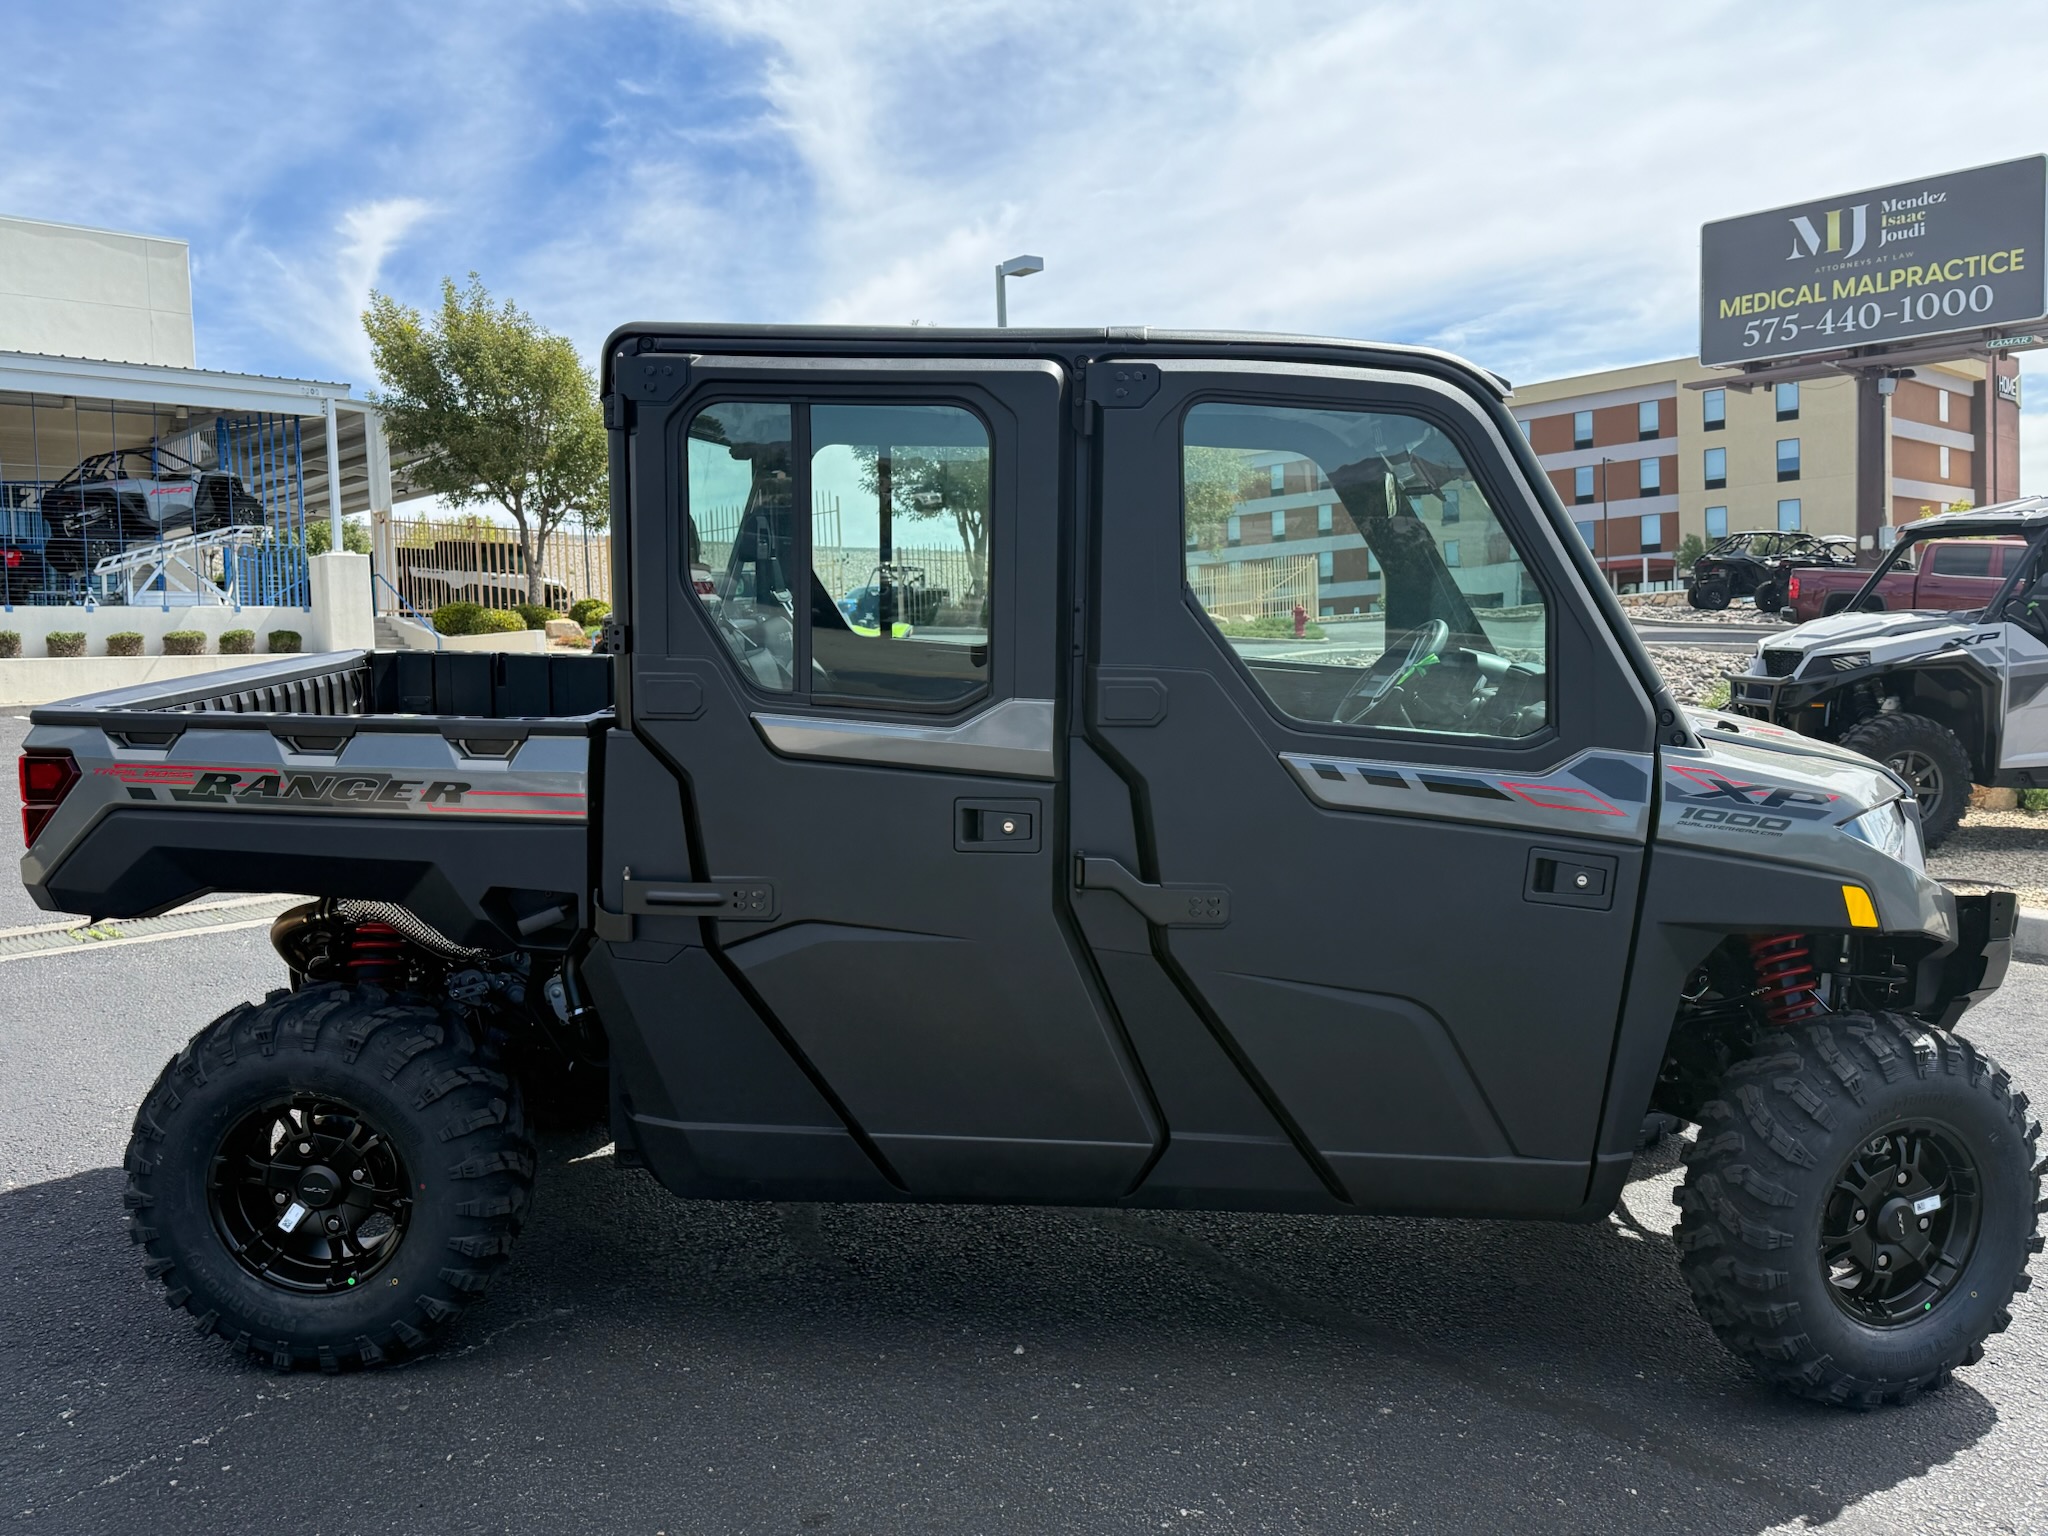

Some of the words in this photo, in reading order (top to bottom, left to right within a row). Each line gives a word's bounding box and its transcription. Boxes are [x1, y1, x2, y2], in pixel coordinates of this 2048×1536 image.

[1881, 191, 1946, 214] Mendez
[1881, 210, 1926, 228] Isaac
[1878, 222, 1926, 248] Joudi
[1814, 258, 1872, 274] ATTORNEYS
[1876, 256, 1889, 264] AT
[1893, 251, 1914, 261] LAW
[1719, 283, 1827, 319] MEDICAL
[1832, 248, 2025, 300] MALPRACTICE
[1743, 284, 1994, 347] 575-440-1000
[1990, 336, 2029, 347] LAMAR
[1952, 631, 2001, 646] XP
[188, 772, 472, 806] RANGER
[1689, 778, 1833, 808] XP
[1676, 820, 1703, 828] DUAL
[1704, 823, 1760, 834] OVERHEAD
[1760, 830, 1784, 838] CAM
[1680, 806, 1792, 831] 1000
